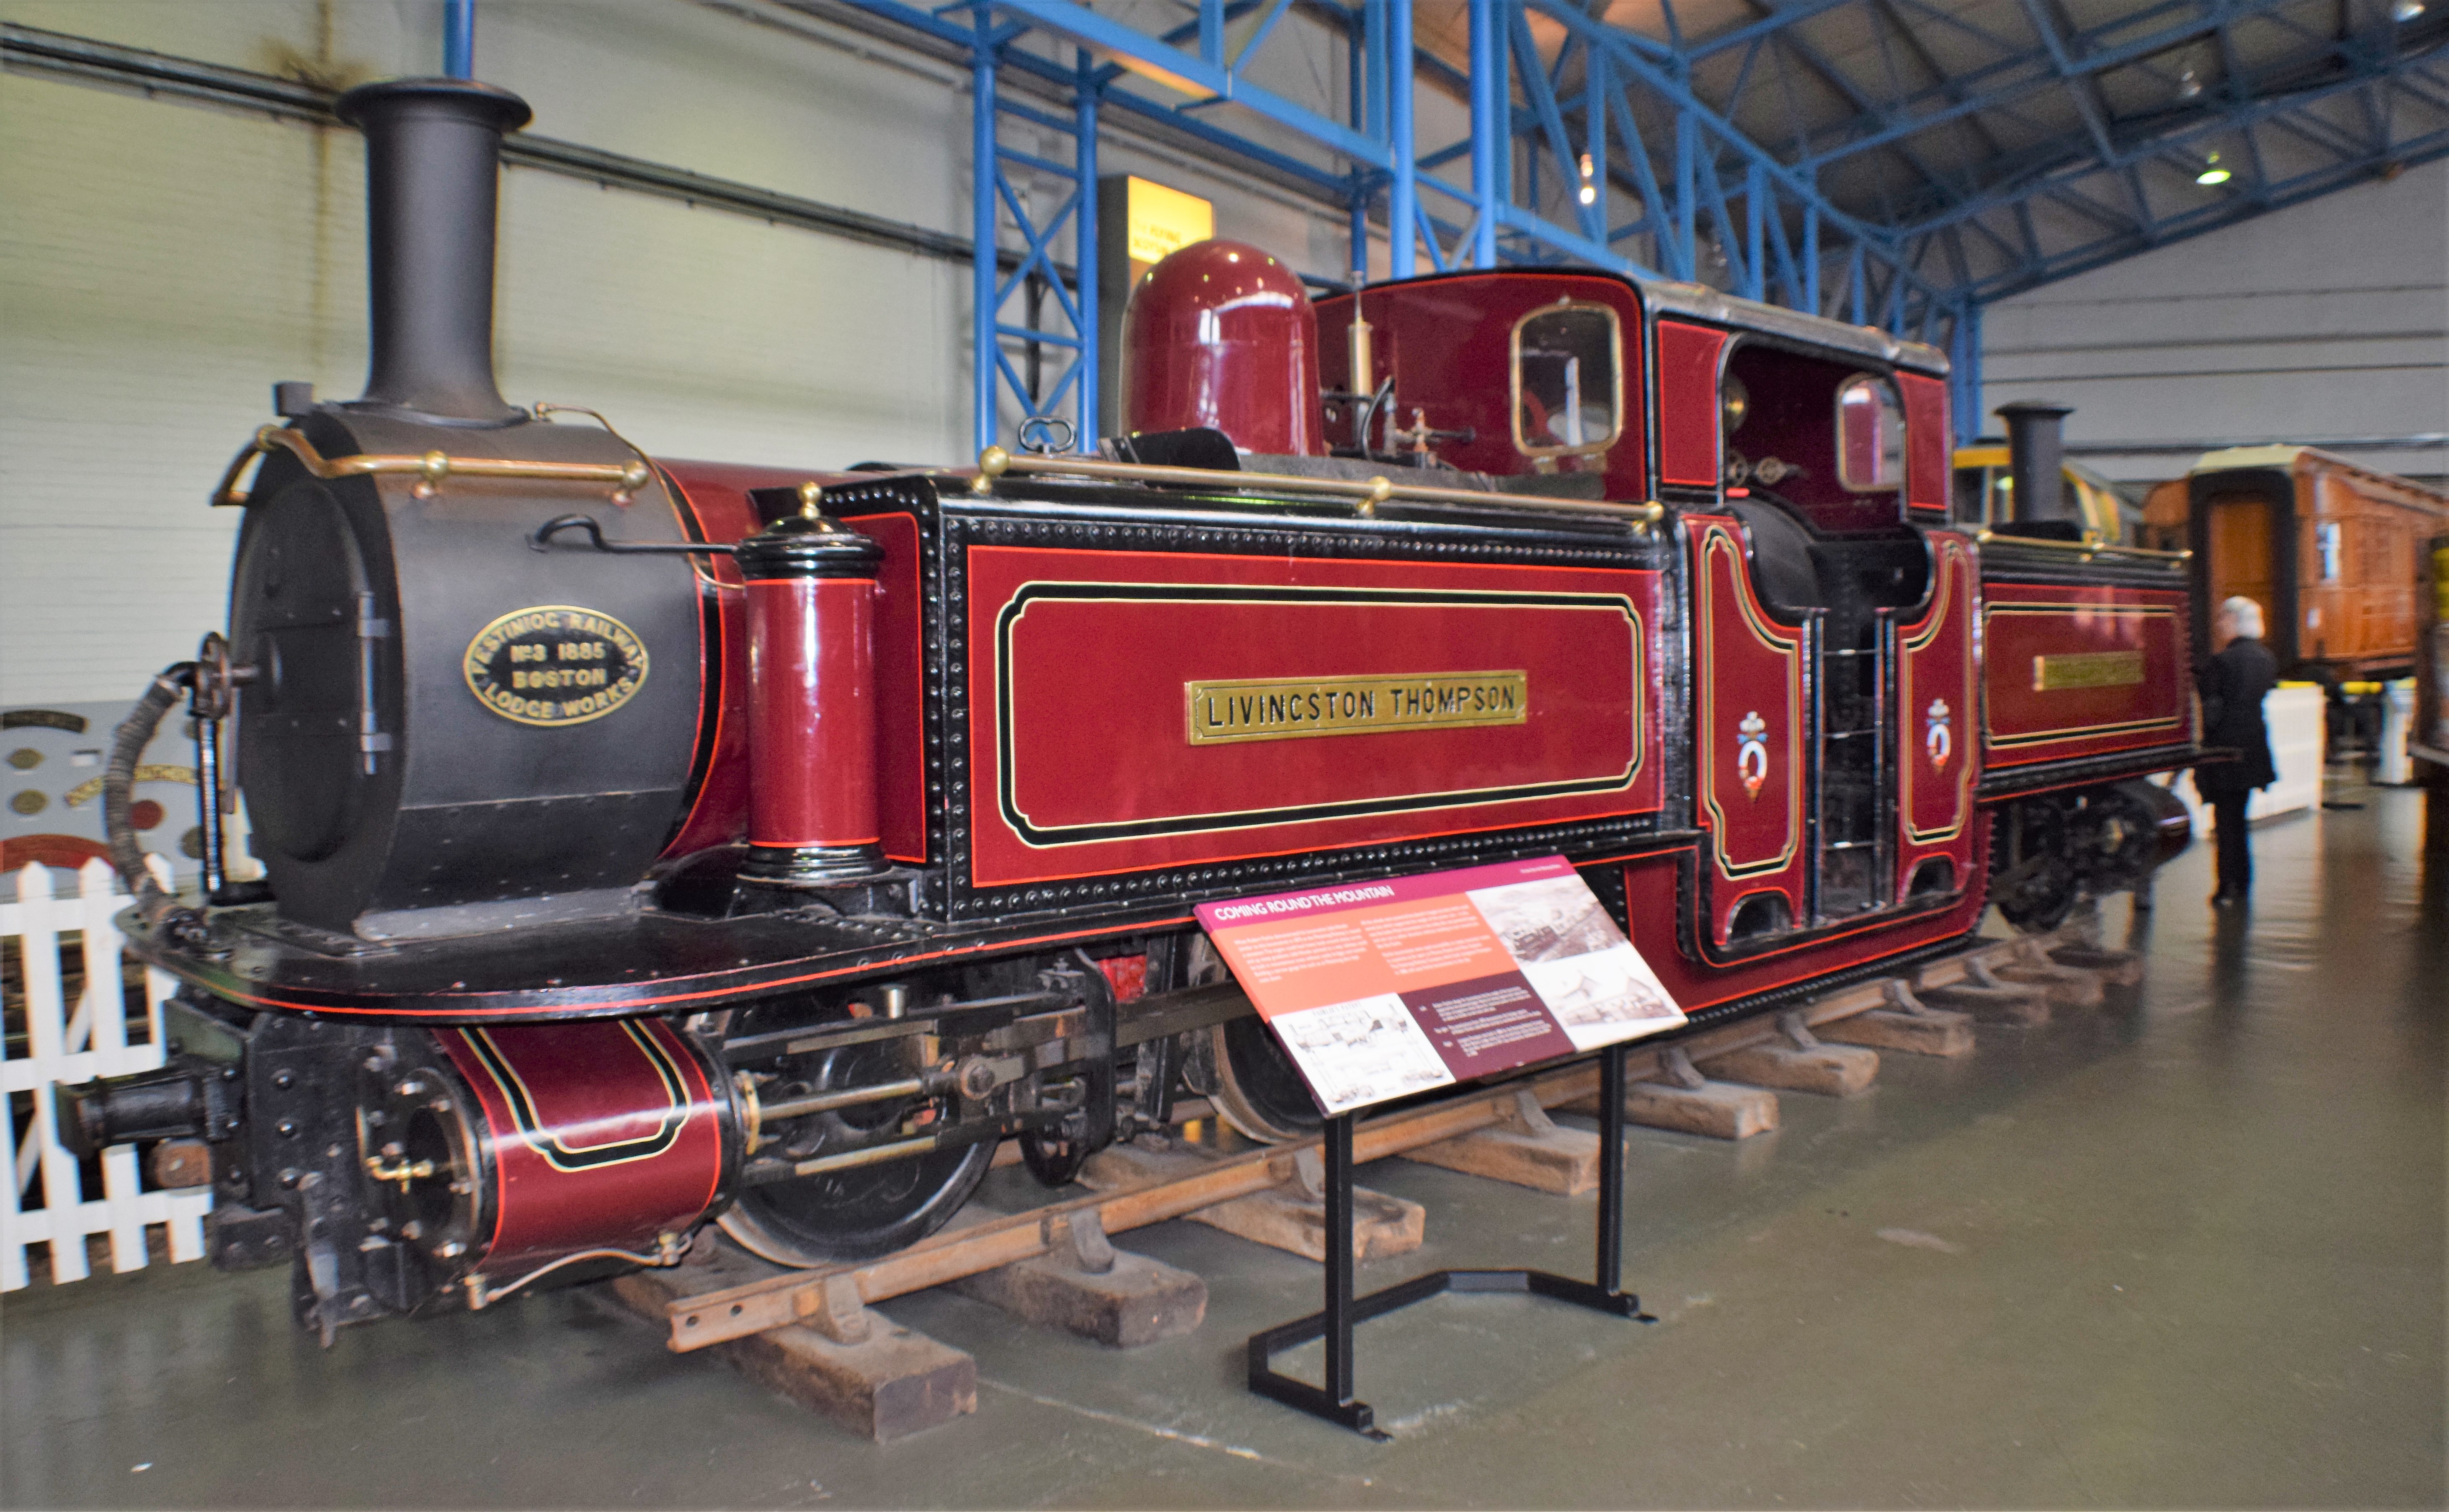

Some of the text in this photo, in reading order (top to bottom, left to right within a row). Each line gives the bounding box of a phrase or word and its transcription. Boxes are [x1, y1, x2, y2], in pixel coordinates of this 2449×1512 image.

[558, 642, 606, 661] 1885
[569, 614, 644, 668] RAILWAY
[512, 668, 607, 689] BOSTON
[562, 677, 635, 717] WORKS
[1391, 685, 1516, 717] THOMPSON
[1215, 885, 1395, 921] COMING ROUND THE MOUNTAIN
